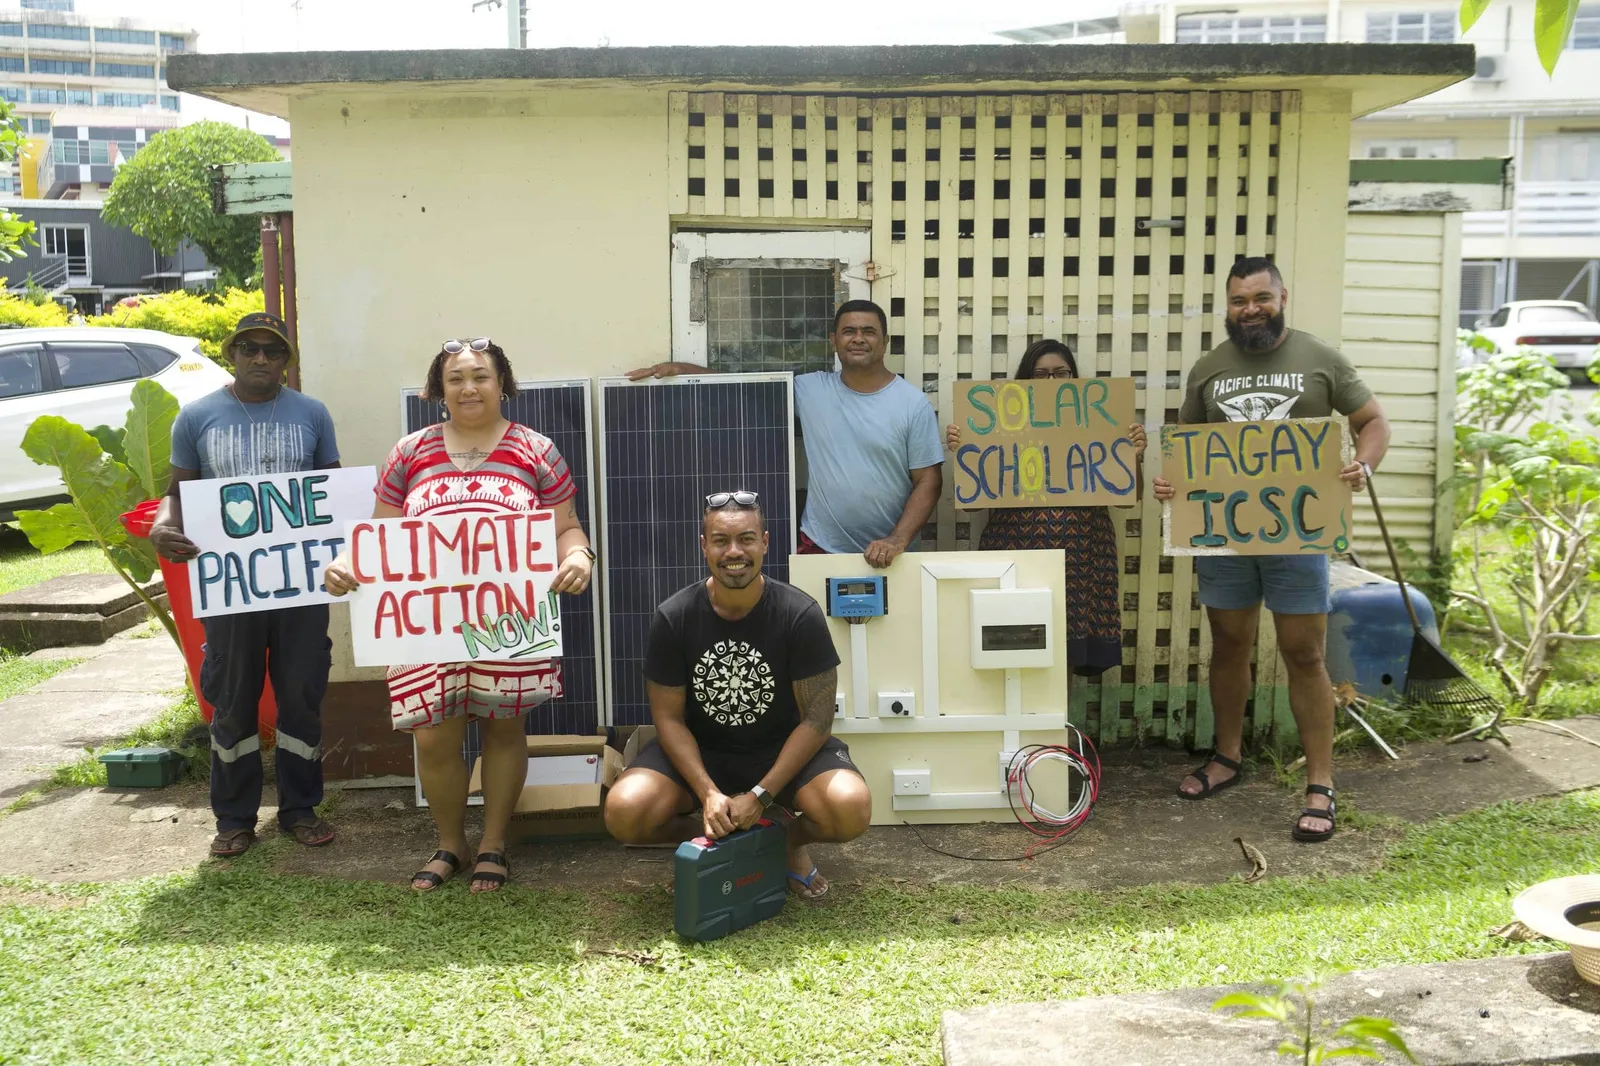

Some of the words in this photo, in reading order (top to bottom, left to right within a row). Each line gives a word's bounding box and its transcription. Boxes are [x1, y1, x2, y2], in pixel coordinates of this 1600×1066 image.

[967, 379, 1118, 435] SOLAR
[1213, 376, 1252, 399] PACIFIC
[1256, 373, 1305, 392] CLIMATE
[956, 437, 1136, 504] SCHOLARS
[1172, 421, 1331, 481] TAGAY
[220, 475, 334, 538] ONE
[352, 512, 554, 585] CLIMATE
[374, 580, 536, 639] ACTION
[460, 588, 561, 660] NOW!
